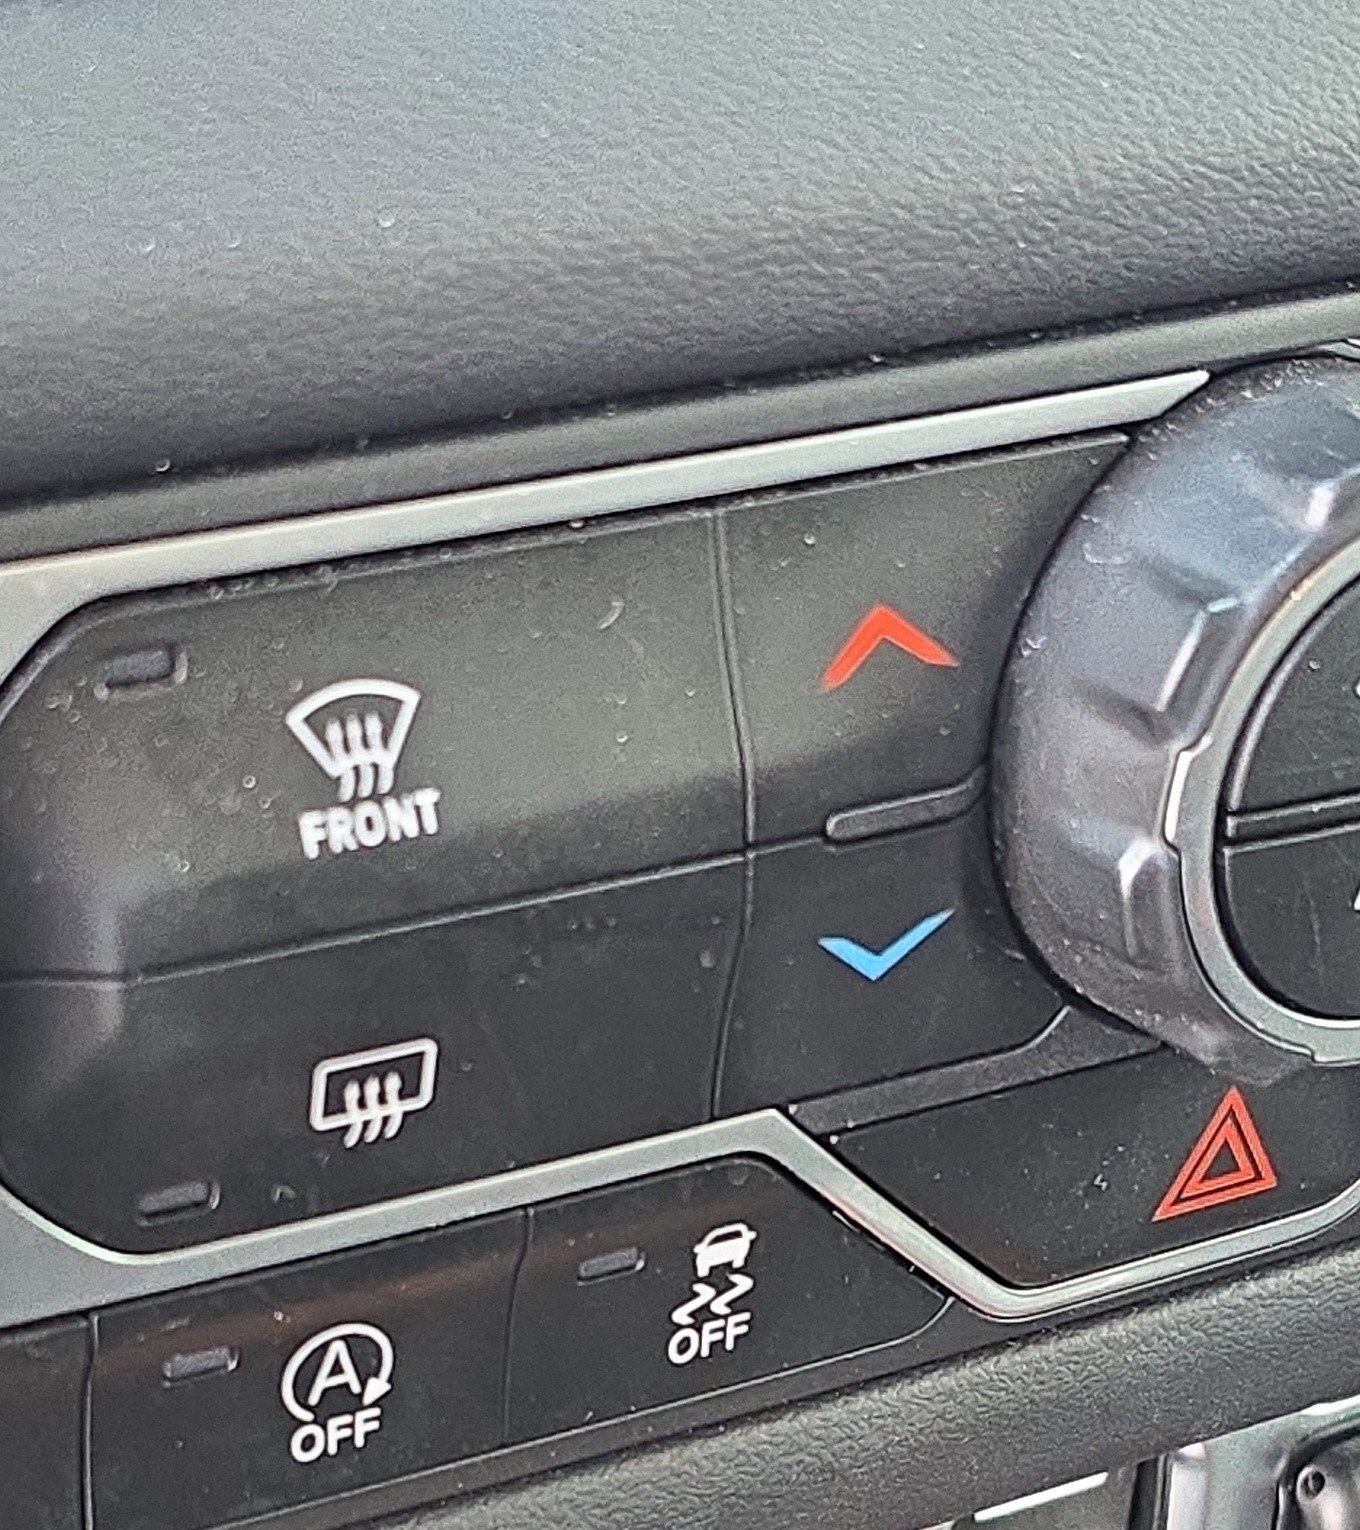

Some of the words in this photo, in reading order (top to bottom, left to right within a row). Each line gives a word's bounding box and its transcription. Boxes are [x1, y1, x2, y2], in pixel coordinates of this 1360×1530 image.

[298, 788, 441, 860] FRONT
[667, 1312, 751, 1364] OFF
[290, 1407, 381, 1463] OFF
